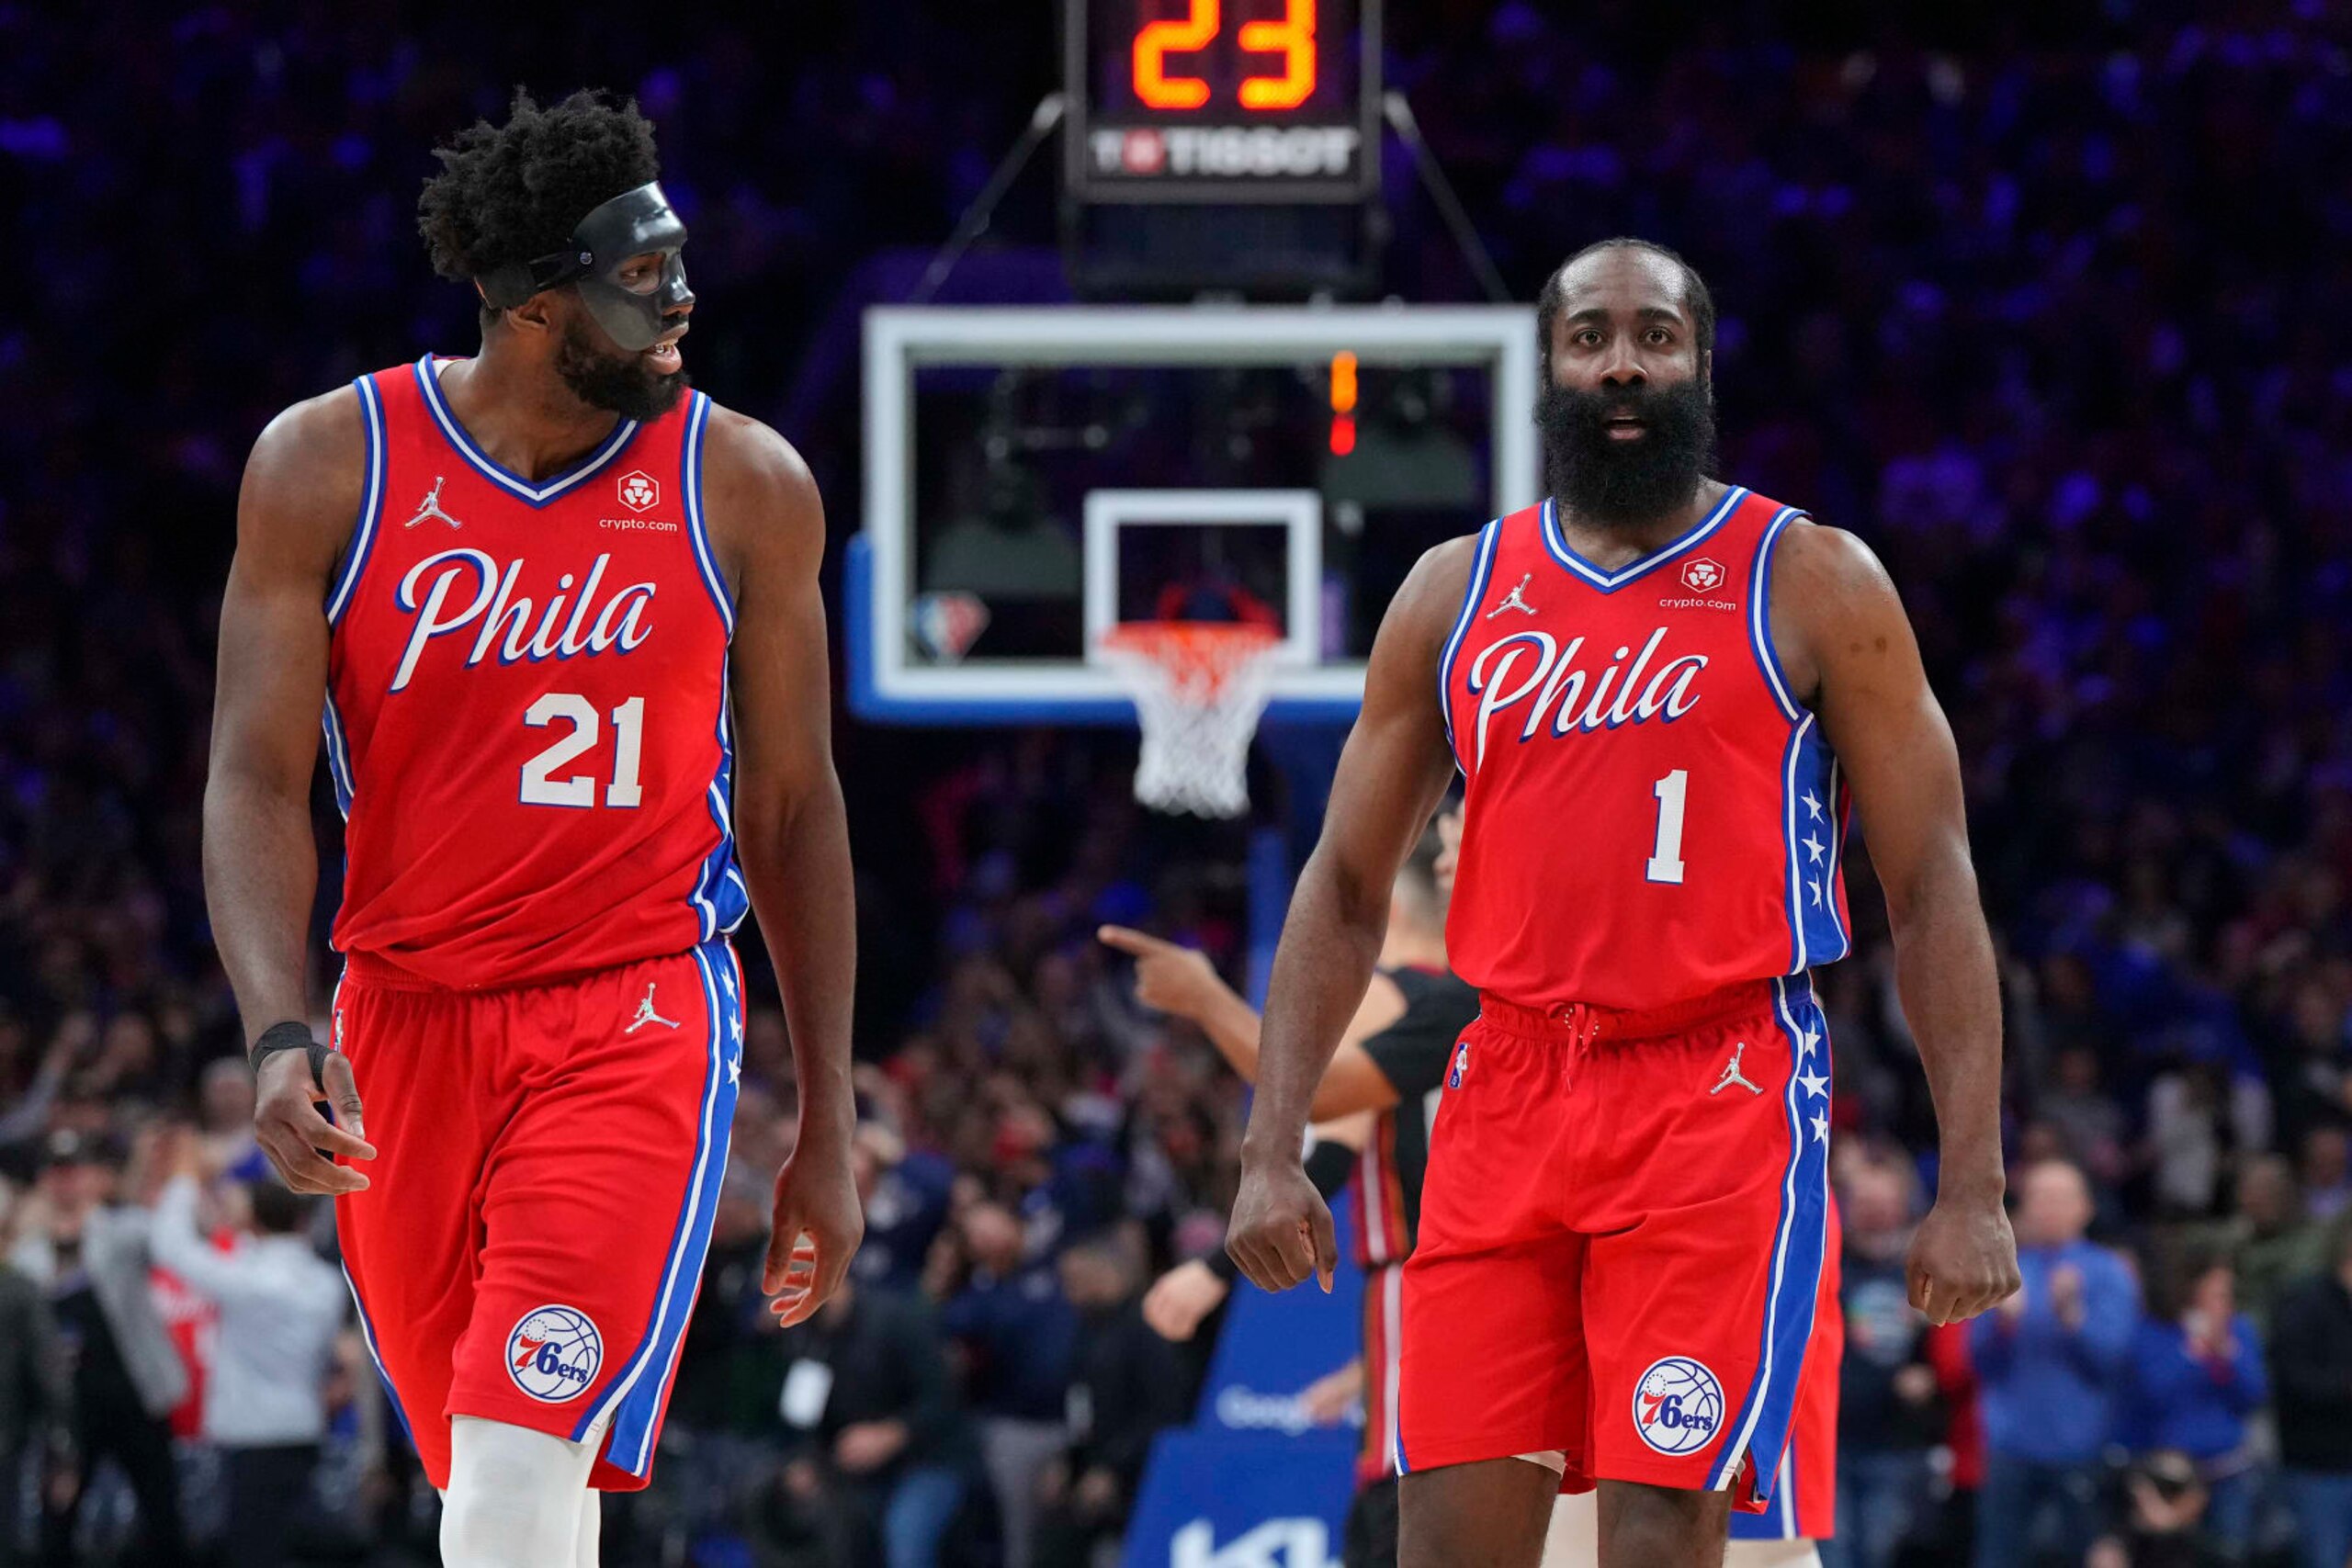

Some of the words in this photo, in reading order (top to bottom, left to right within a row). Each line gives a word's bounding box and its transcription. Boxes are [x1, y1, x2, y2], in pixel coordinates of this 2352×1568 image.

[1133, 0, 1316, 108] 23
[598, 517, 678, 533] crypto.com
[388, 548, 656, 694] Phila
[1658, 597, 1736, 612] crypto.com
[519, 693, 645, 807] 21
[1467, 626, 1709, 775] Phila
[1645, 769, 1688, 885] 1
[514, 1334, 588, 1383] 76ers
[1642, 1390, 1713, 1431] 76ers
